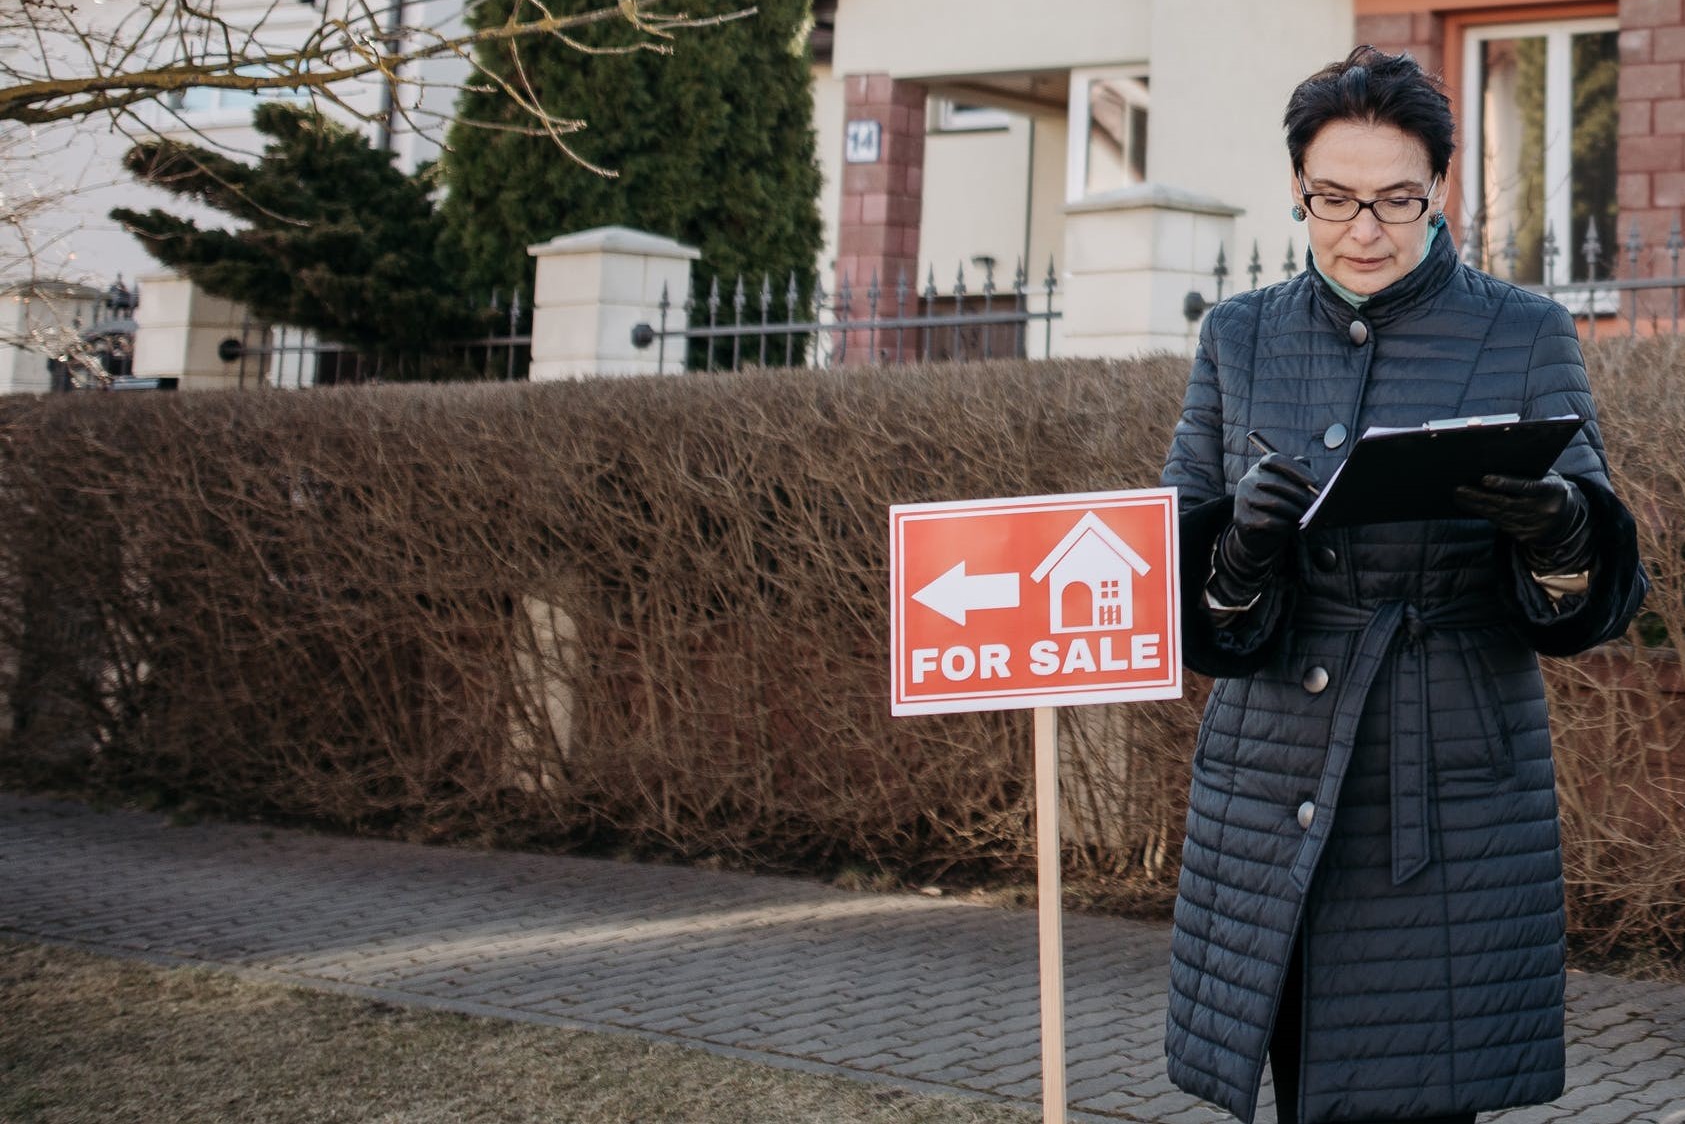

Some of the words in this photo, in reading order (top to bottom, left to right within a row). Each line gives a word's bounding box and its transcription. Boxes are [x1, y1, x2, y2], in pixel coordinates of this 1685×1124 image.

[848, 131, 873, 153] 14
[912, 644, 1012, 683] FOR
[1029, 633, 1160, 676] SALE
